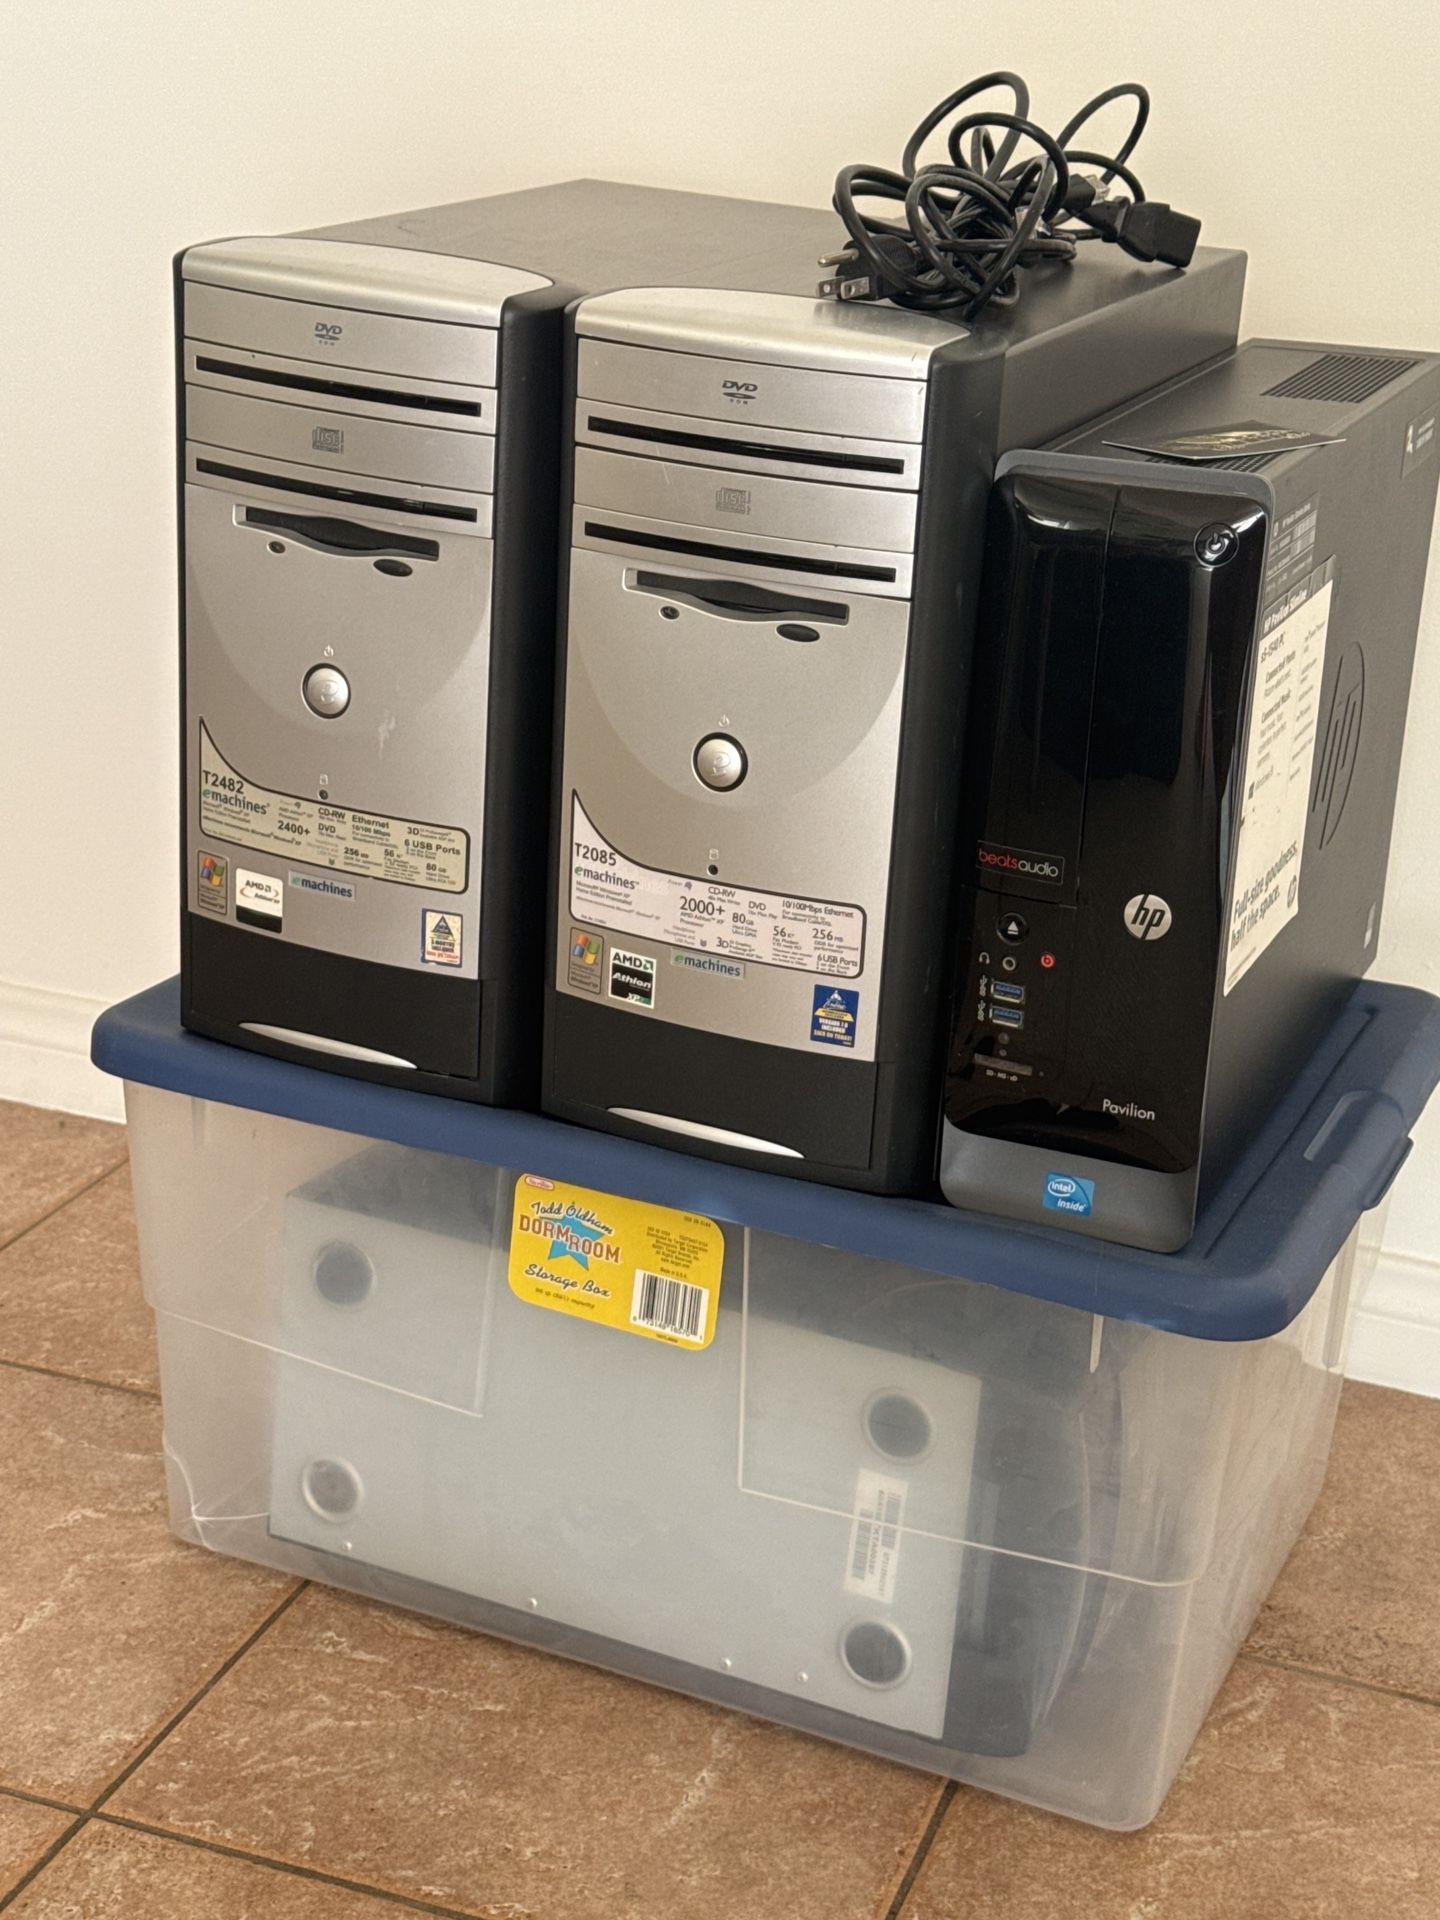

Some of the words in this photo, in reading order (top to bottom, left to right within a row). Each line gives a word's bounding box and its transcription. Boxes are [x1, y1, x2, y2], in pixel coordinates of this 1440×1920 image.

[314, 322, 343, 335] DVD
[722, 380, 758, 392] DVD
[202, 769, 245, 795] T2482
[318, 806, 346, 820] CD-RW
[277, 820, 311, 836] 2400+
[318, 822, 336, 834] DVD
[351, 814, 390, 829] Ethernet
[407, 826, 420, 836] 3D
[412, 840, 433, 851] USB
[435, 843, 461, 856] Ports
[574, 842, 617, 867] T2085
[245, 879, 265, 892] AMD
[291, 875, 353, 898] emachines
[707, 886, 736, 898] CD-RW
[680, 895, 726, 916] 2000+
[748, 900, 767, 911] DVD
[824, 906, 854, 919] Ethernet
[773, 925, 787, 938] 56
[812, 927, 834, 941] 256
[716, 936, 729, 949] 3D
[612, 952, 643, 969] AMD
[673, 953, 741, 977] emachines
[612, 971, 652, 989] Athlon
[1102, 1098, 1156, 1121] Pavilion
[1051, 1181, 1073, 1194] intel
[1057, 1198, 1087, 1213] inside
[530, 1200, 563, 1216] Todd
[565, 1203, 613, 1235] Oldham
[525, 1263, 578, 1290] Storage
[582, 1279, 610, 1297] Box
